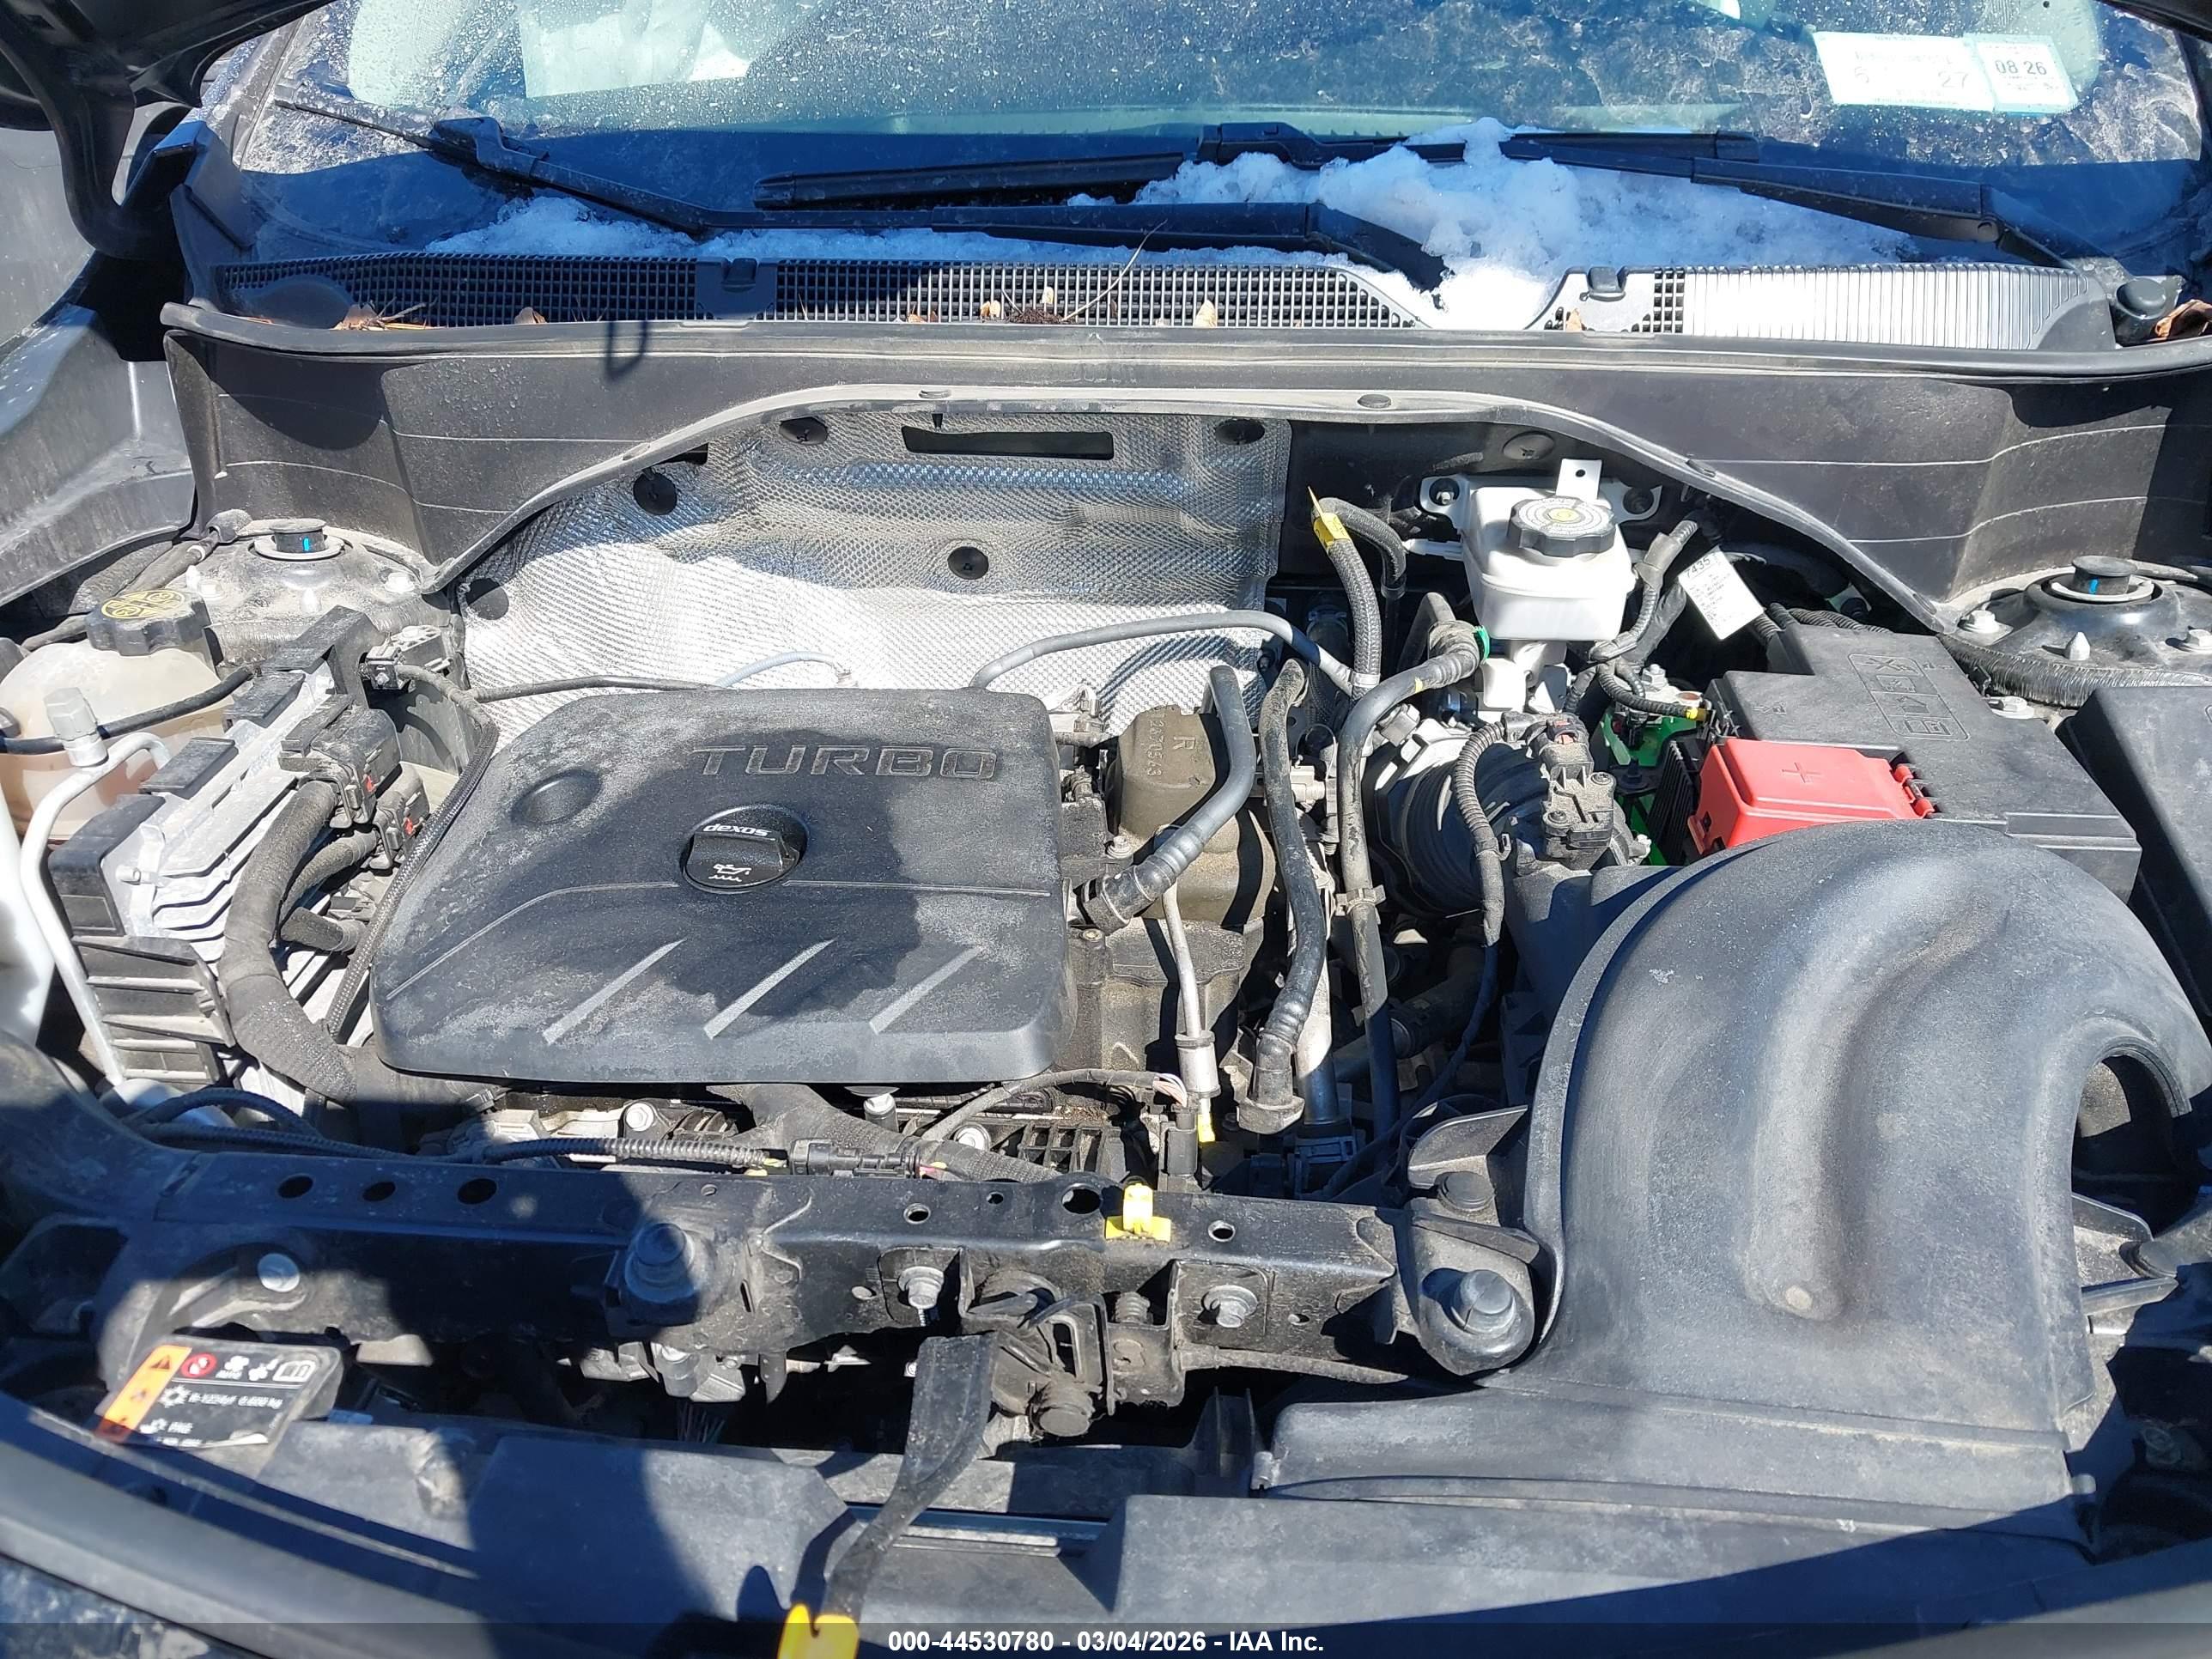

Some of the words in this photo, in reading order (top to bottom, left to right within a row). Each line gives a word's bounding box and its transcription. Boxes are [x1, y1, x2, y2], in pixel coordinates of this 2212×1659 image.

[1994, 59, 2019, 74] 08
[2023, 61, 2047, 76] 26
[1684, 556, 1711, 579] 7435
[1172, 735, 1196, 750] R
[692, 744, 998, 780] TURBO
[703, 823, 772, 836] dexos
